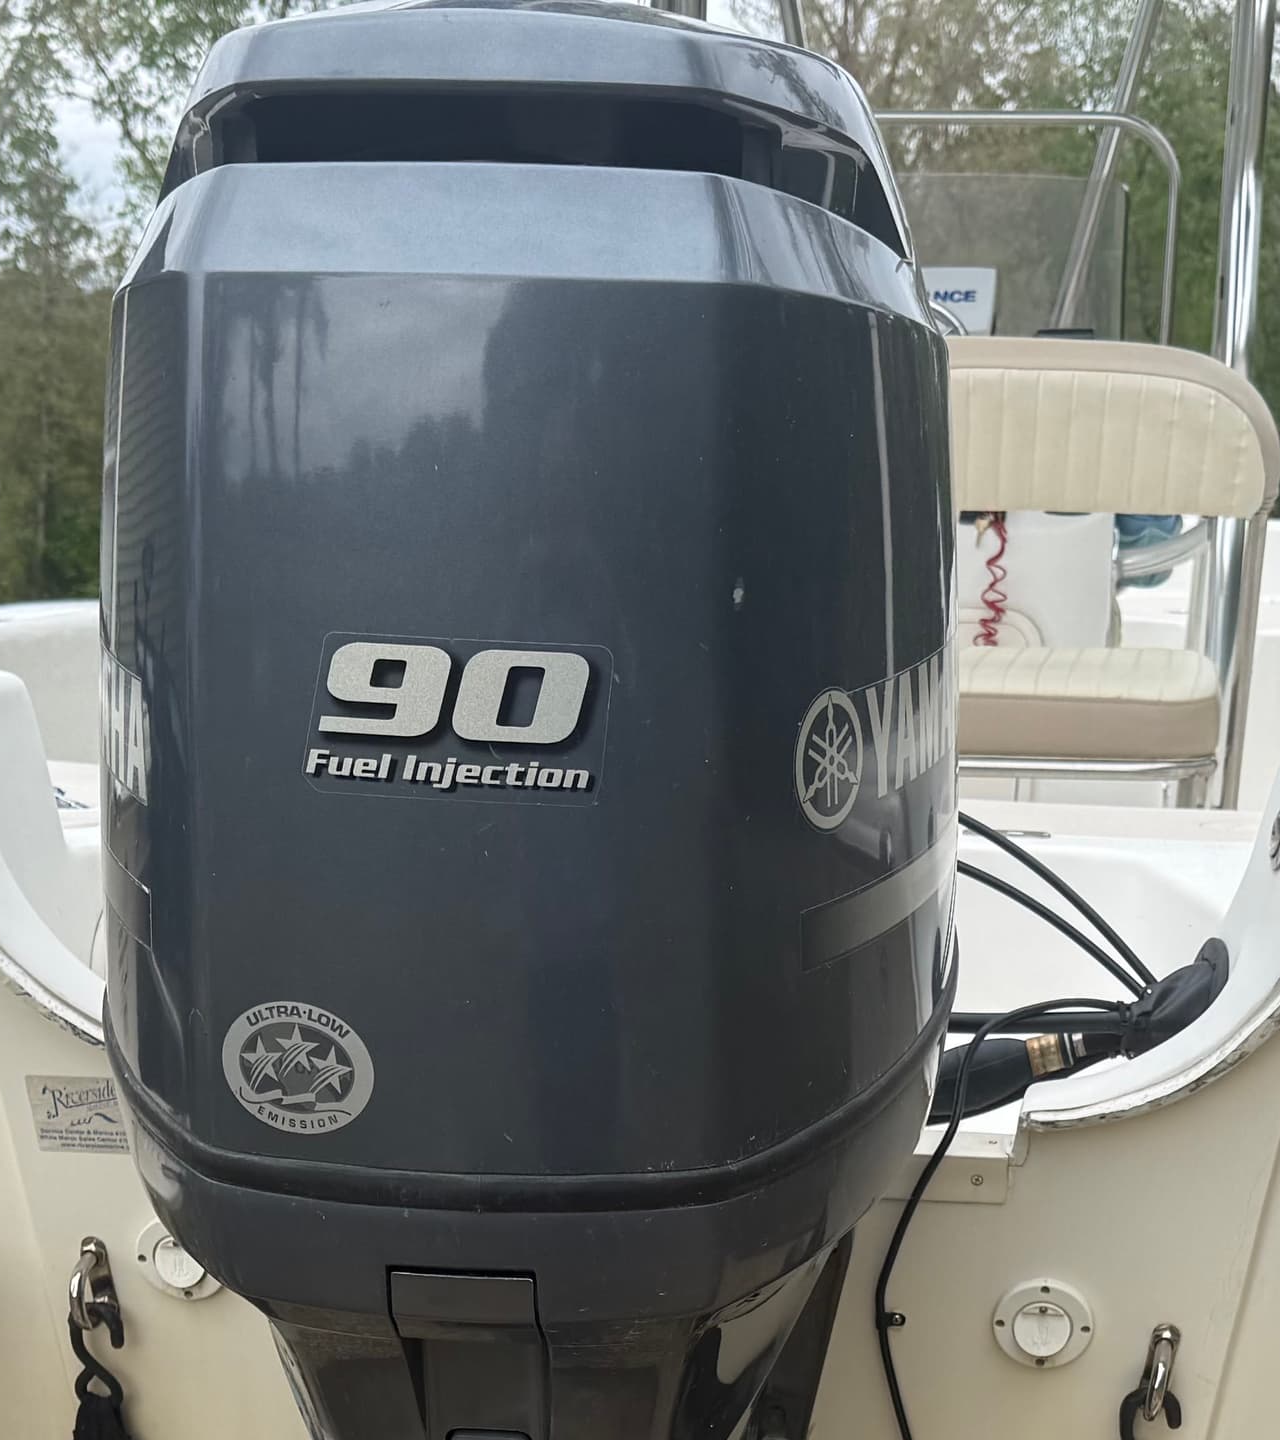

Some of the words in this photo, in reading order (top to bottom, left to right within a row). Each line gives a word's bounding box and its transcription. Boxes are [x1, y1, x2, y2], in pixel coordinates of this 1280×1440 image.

[927, 290, 977, 303] NCE
[318, 641, 590, 744] 90
[305, 748, 392, 779] Fuel
[402, 754, 590, 789] Injection
[257, 1105, 338, 1129] EMISSION
